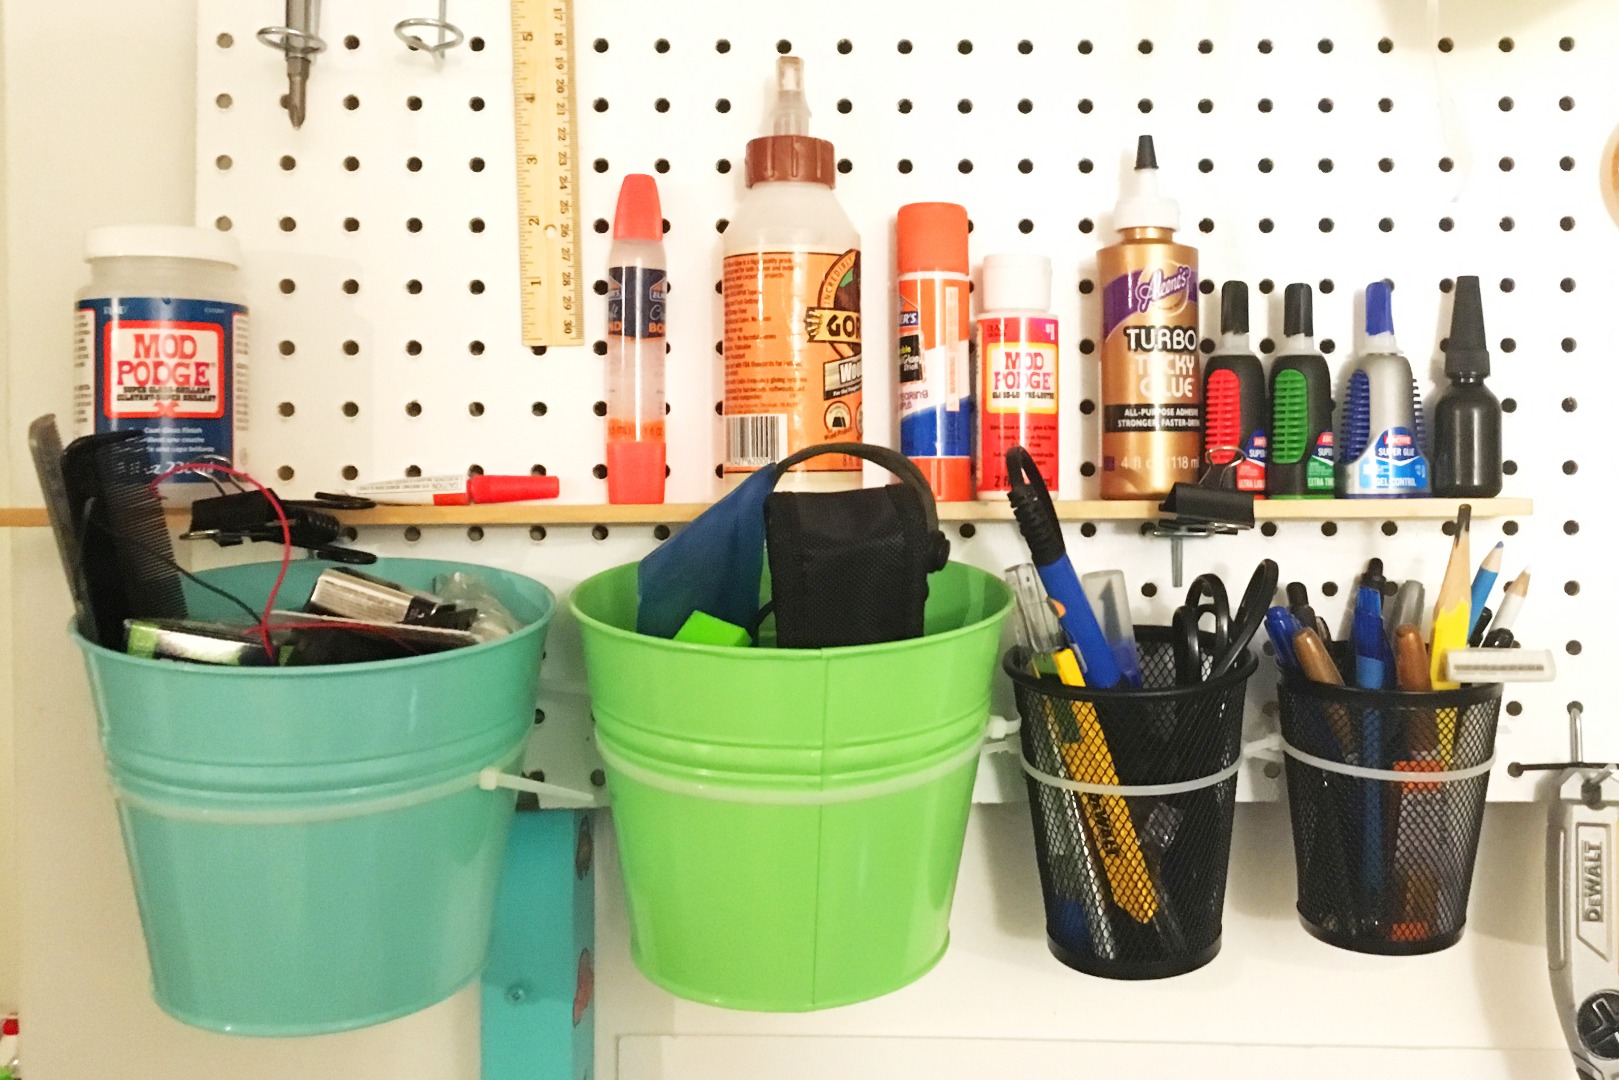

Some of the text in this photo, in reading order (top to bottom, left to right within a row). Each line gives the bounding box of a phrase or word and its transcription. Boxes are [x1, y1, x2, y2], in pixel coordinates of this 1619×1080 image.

[553, 8, 563, 21] 17
[522, 32, 534, 42] 5
[554, 32, 563, 46] 18
[555, 57, 564, 70] 19
[556, 79, 565, 93] 20
[524, 94, 536, 104] 4
[556, 103, 565, 116] 21
[558, 127, 566, 141] 22
[526, 156, 538, 165] 3
[558, 152, 567, 166] 23
[559, 176, 568, 190] 24
[560, 200, 569, 214] 25
[528, 217, 540, 226] 2
[560, 224, 570, 238] 26
[561, 248, 571, 261] 27
[562, 272, 571, 286] 28
[563, 296, 572, 311] 29
[564, 320, 573, 334] 30
[133, 333, 198, 360] MOD
[1126, 328, 1197, 351] TURBO
[116, 360, 211, 387] PODGE
[1584, 840, 1602, 922] DEWALT
